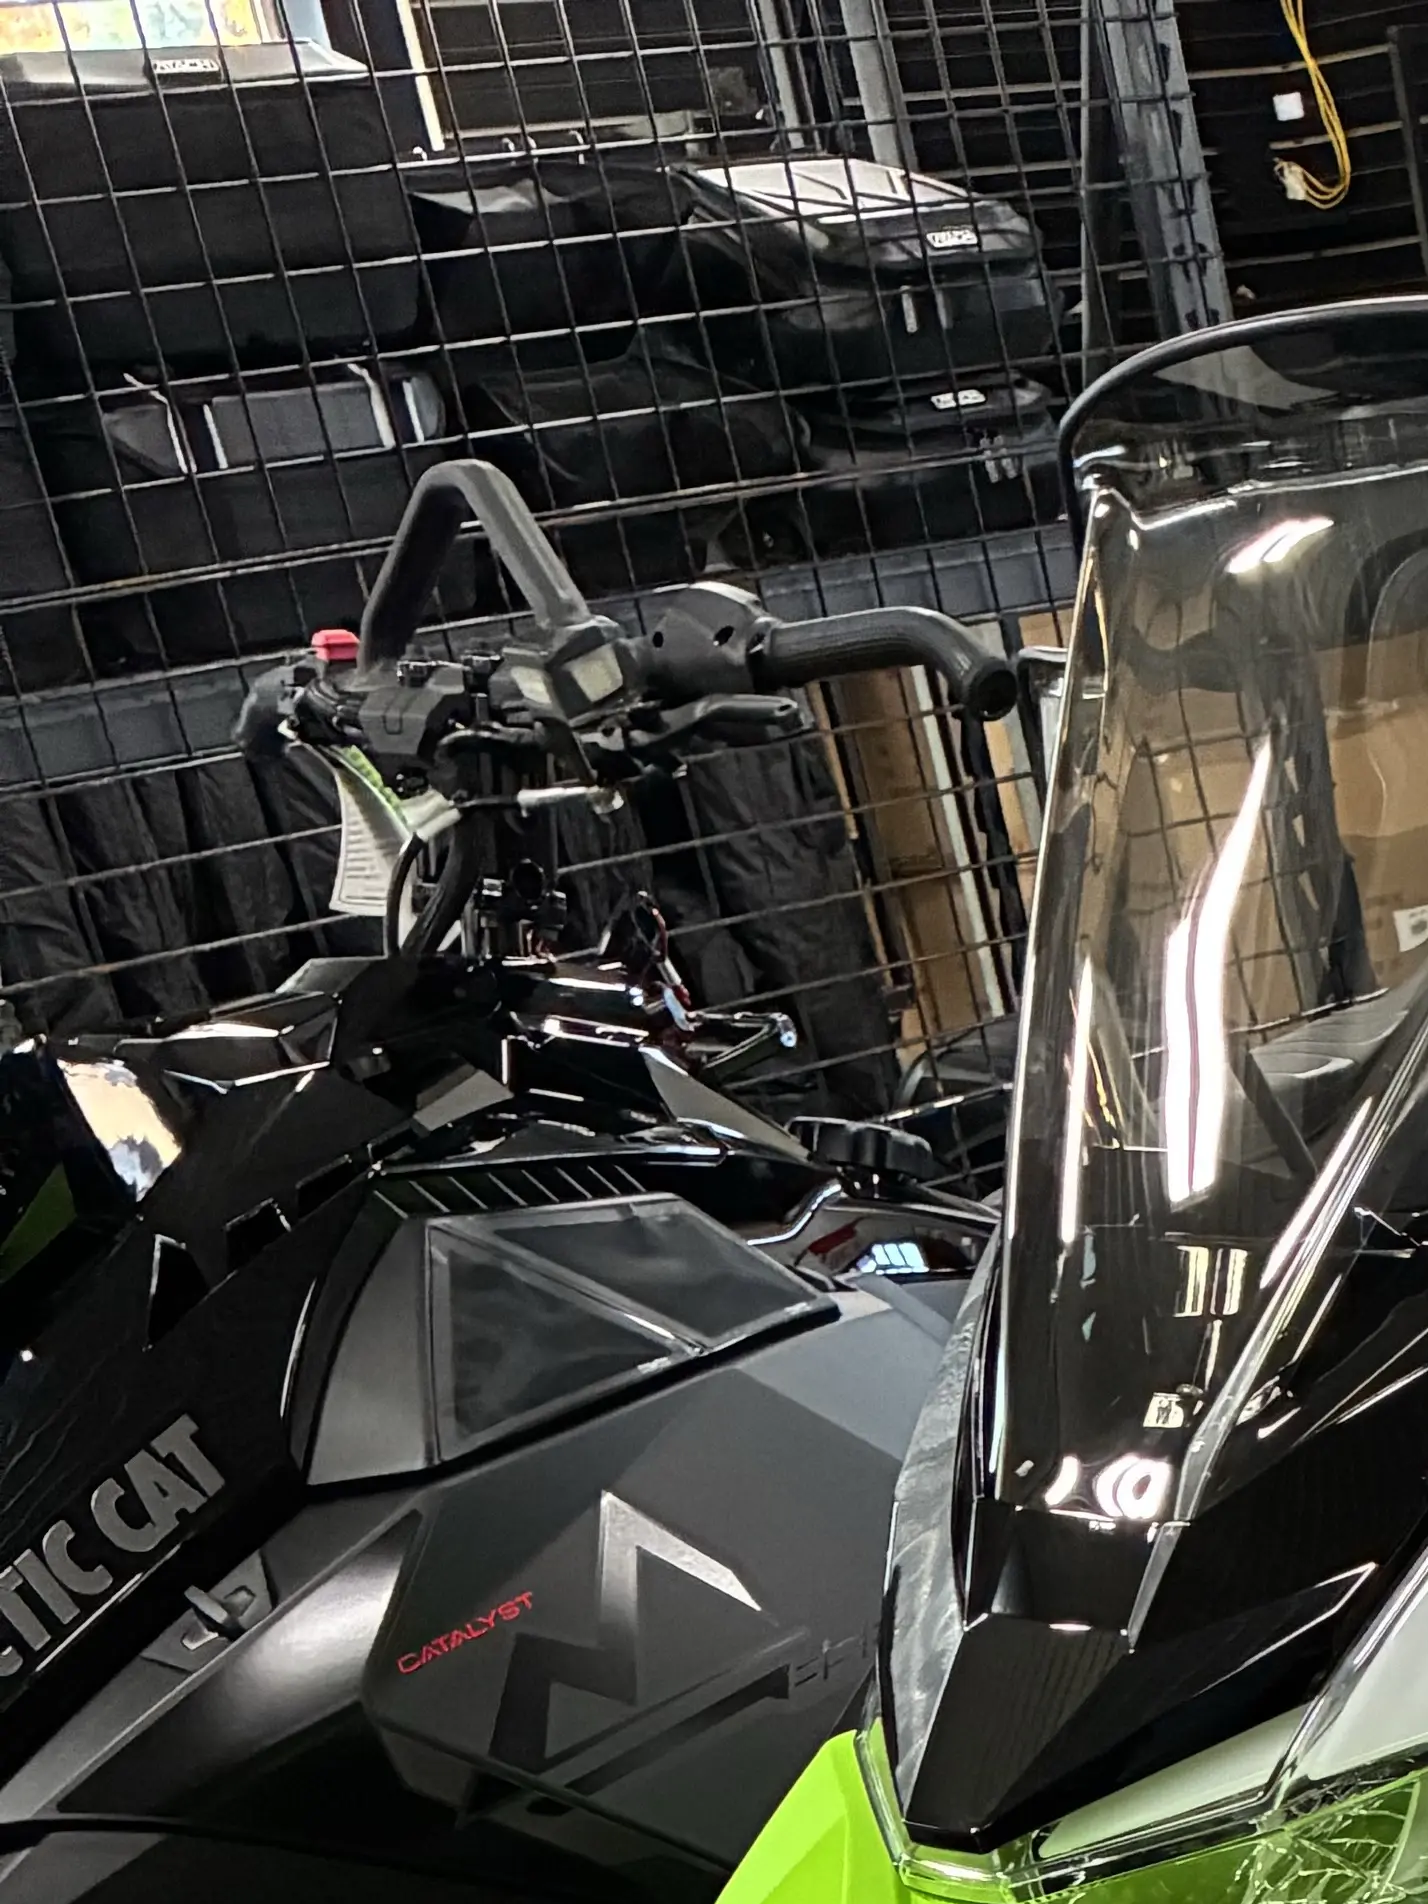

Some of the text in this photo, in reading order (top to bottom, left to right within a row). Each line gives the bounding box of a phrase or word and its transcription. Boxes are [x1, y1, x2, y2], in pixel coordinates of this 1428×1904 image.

[0, 1413, 226, 1677] TIC CAT
[396, 1590, 536, 1675] CATALYST
